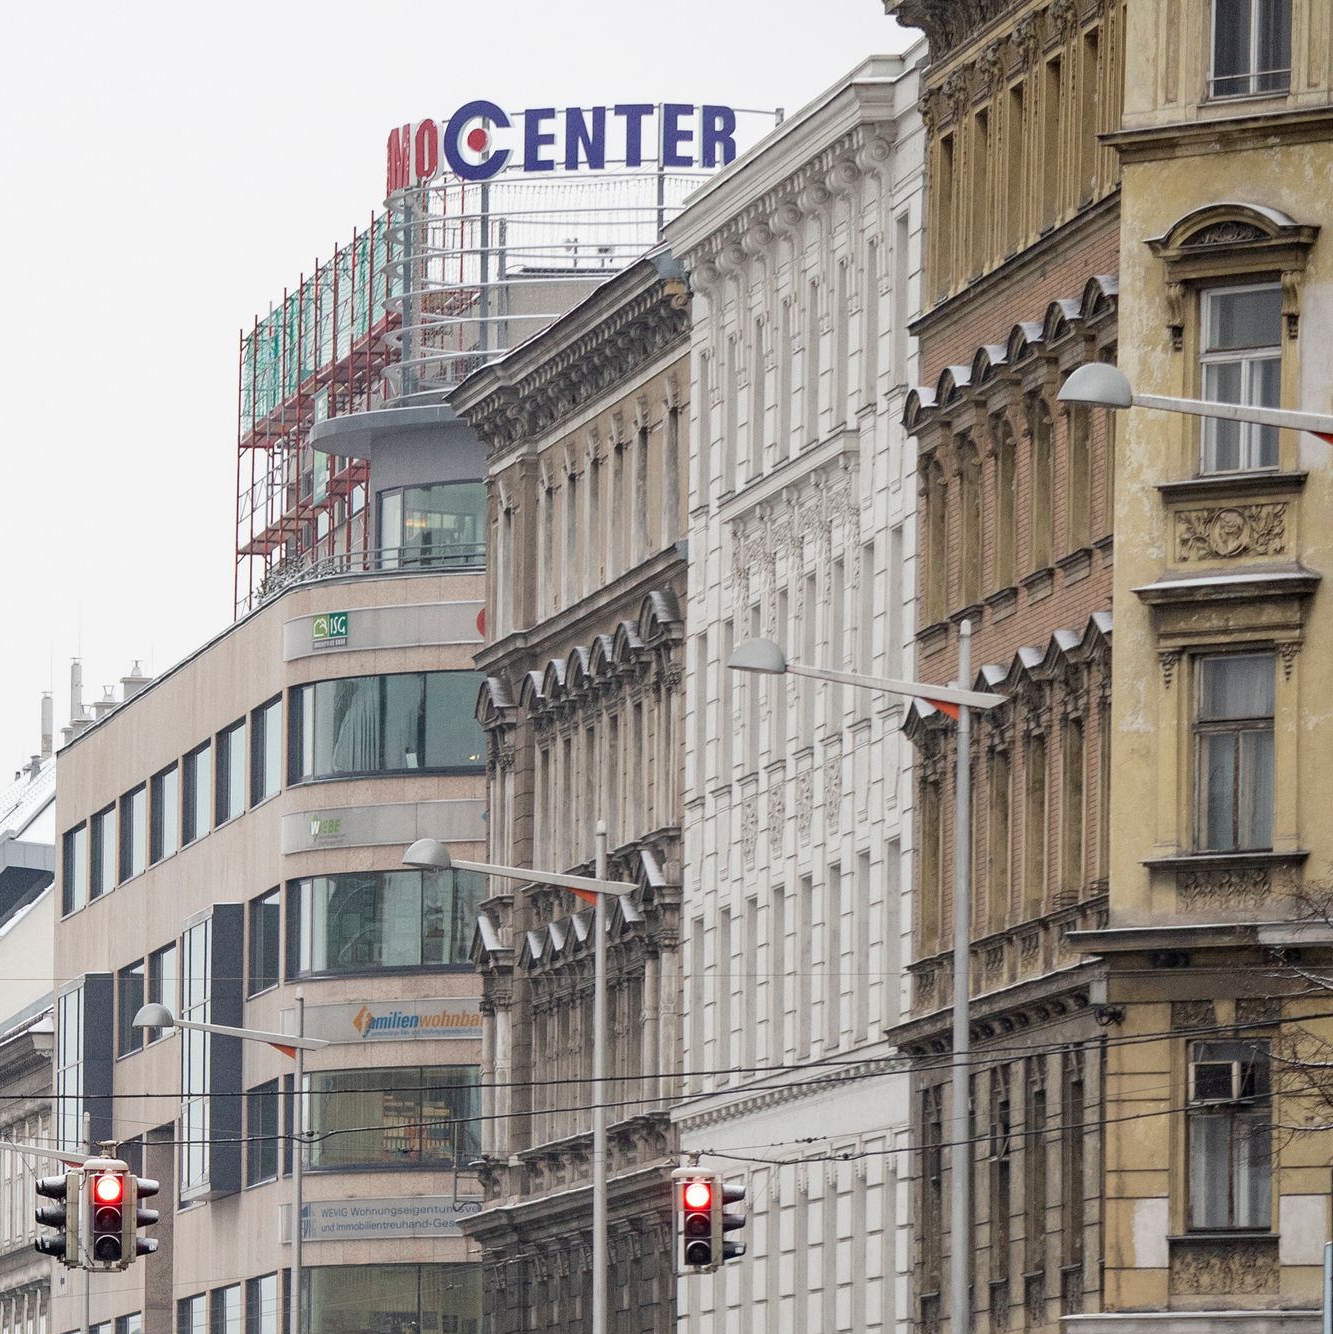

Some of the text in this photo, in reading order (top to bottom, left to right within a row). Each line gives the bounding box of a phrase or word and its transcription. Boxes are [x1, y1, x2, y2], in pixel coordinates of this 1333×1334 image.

[329, 615, 346, 636] ISG
[322, 1219, 459, 1232] und Immobilientreuhand-Ges
